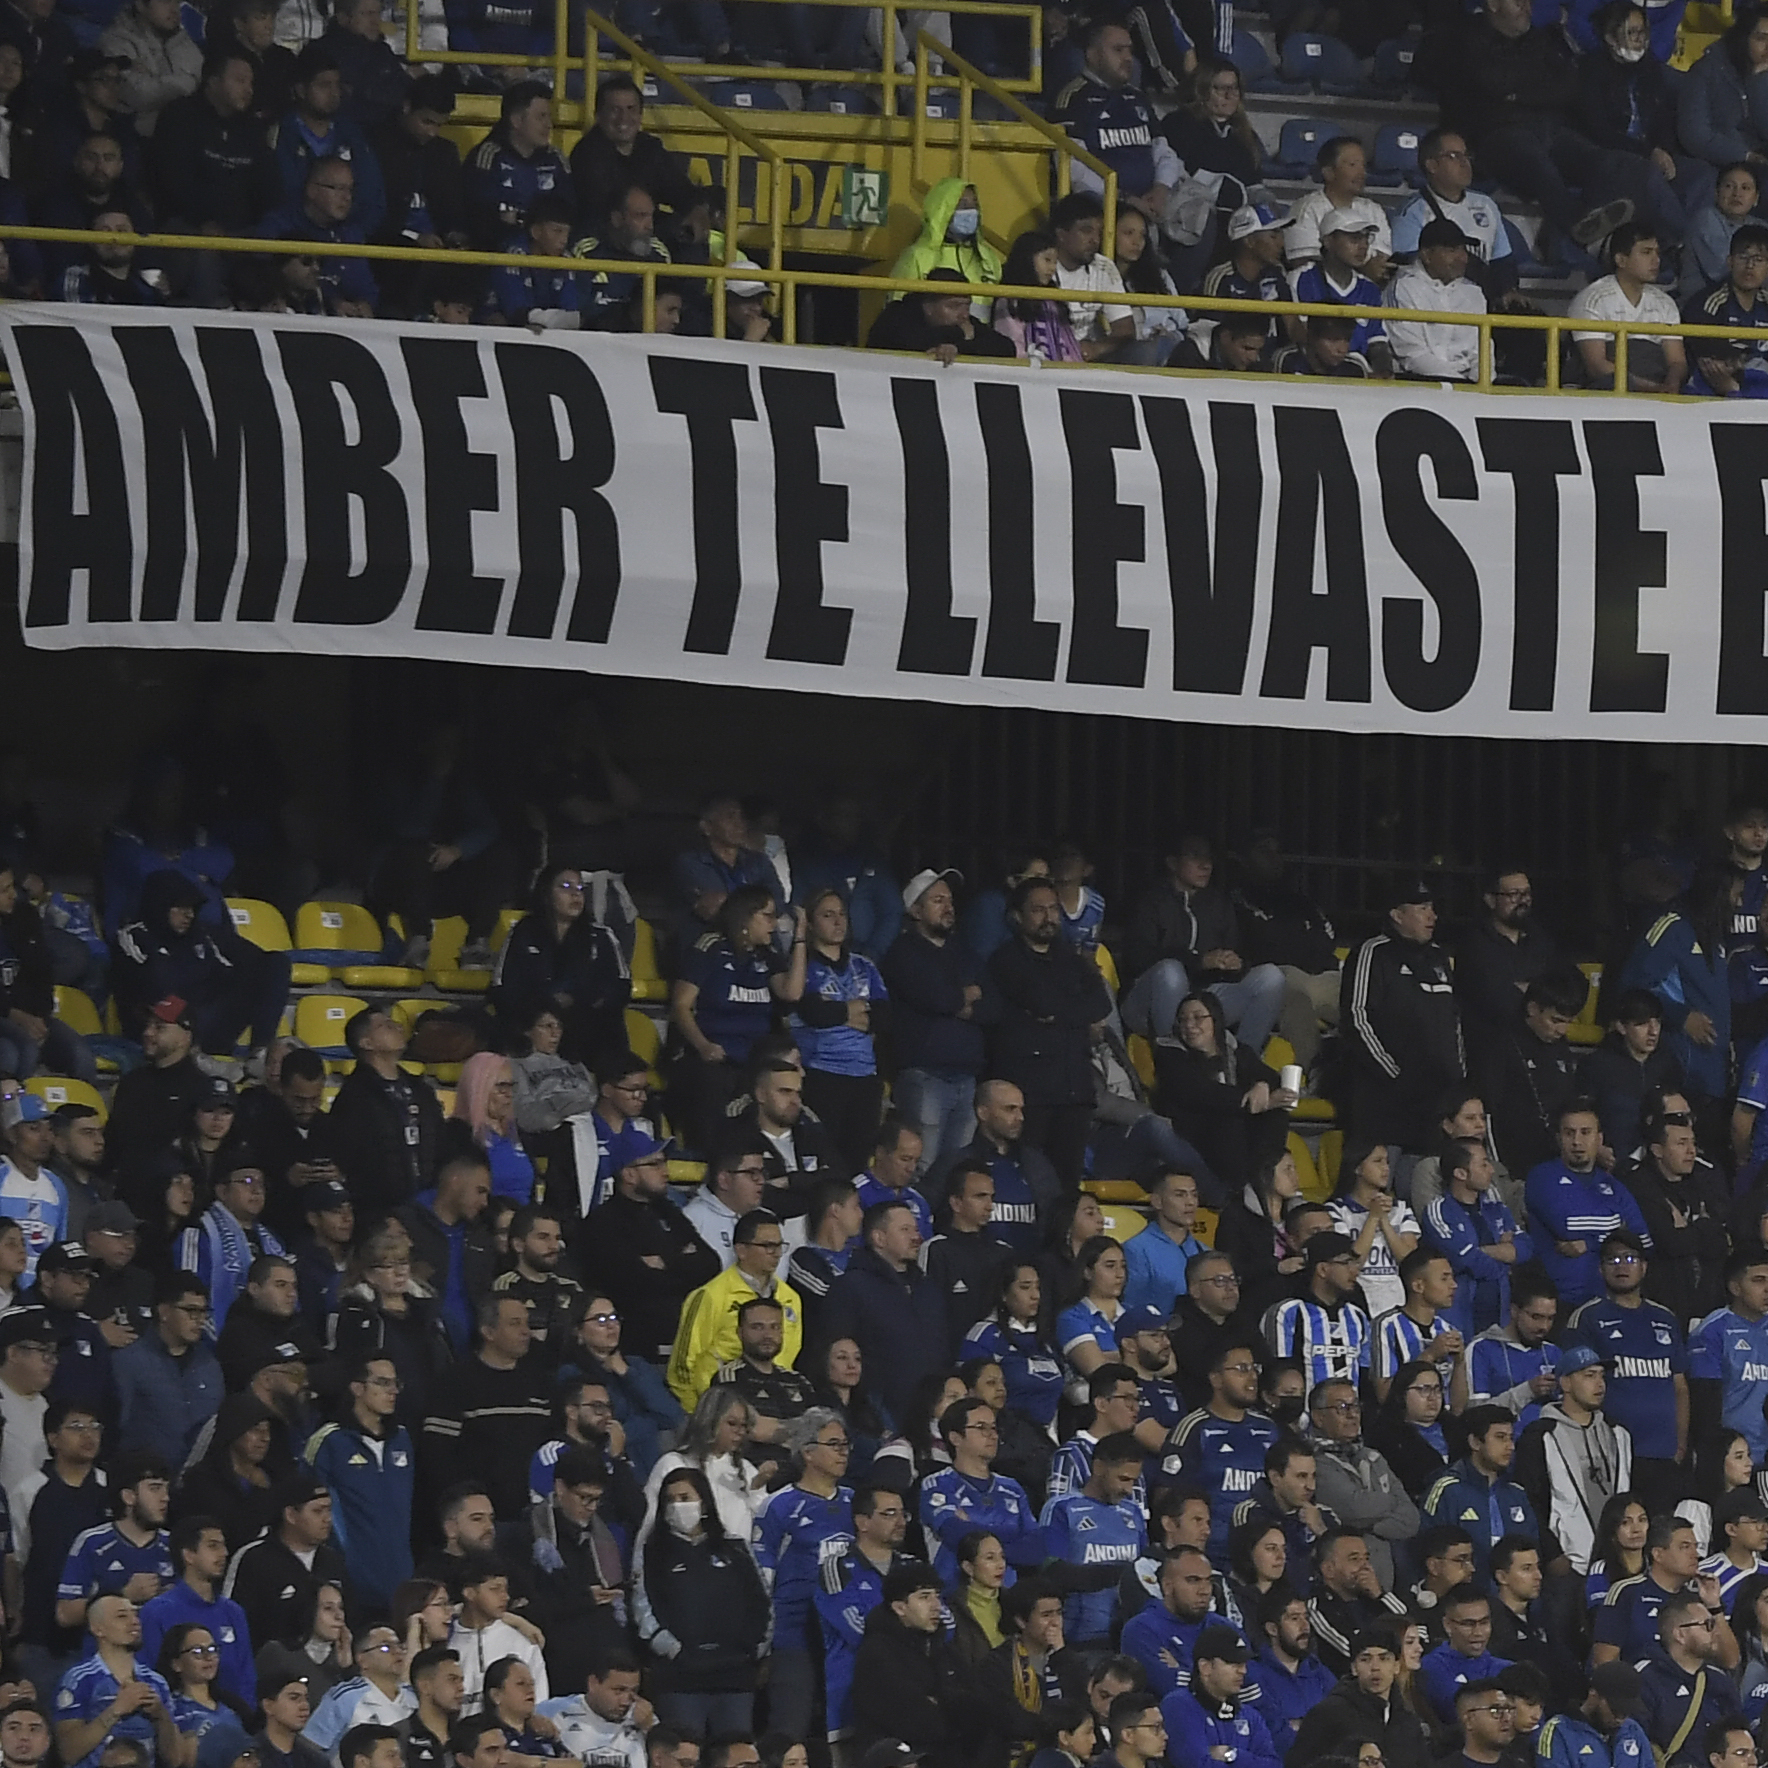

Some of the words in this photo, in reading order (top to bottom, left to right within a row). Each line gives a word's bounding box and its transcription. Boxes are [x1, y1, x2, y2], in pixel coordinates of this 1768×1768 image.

[10, 325, 621, 644] AMBER
[649, 355, 854, 664] TE
[890, 377, 1669, 714] LLEVASTE
[990, 1203, 1037, 1222] NDINA
[1614, 1355, 1672, 1378] ANDINA
[1084, 1543, 1137, 1563] ANDINA
